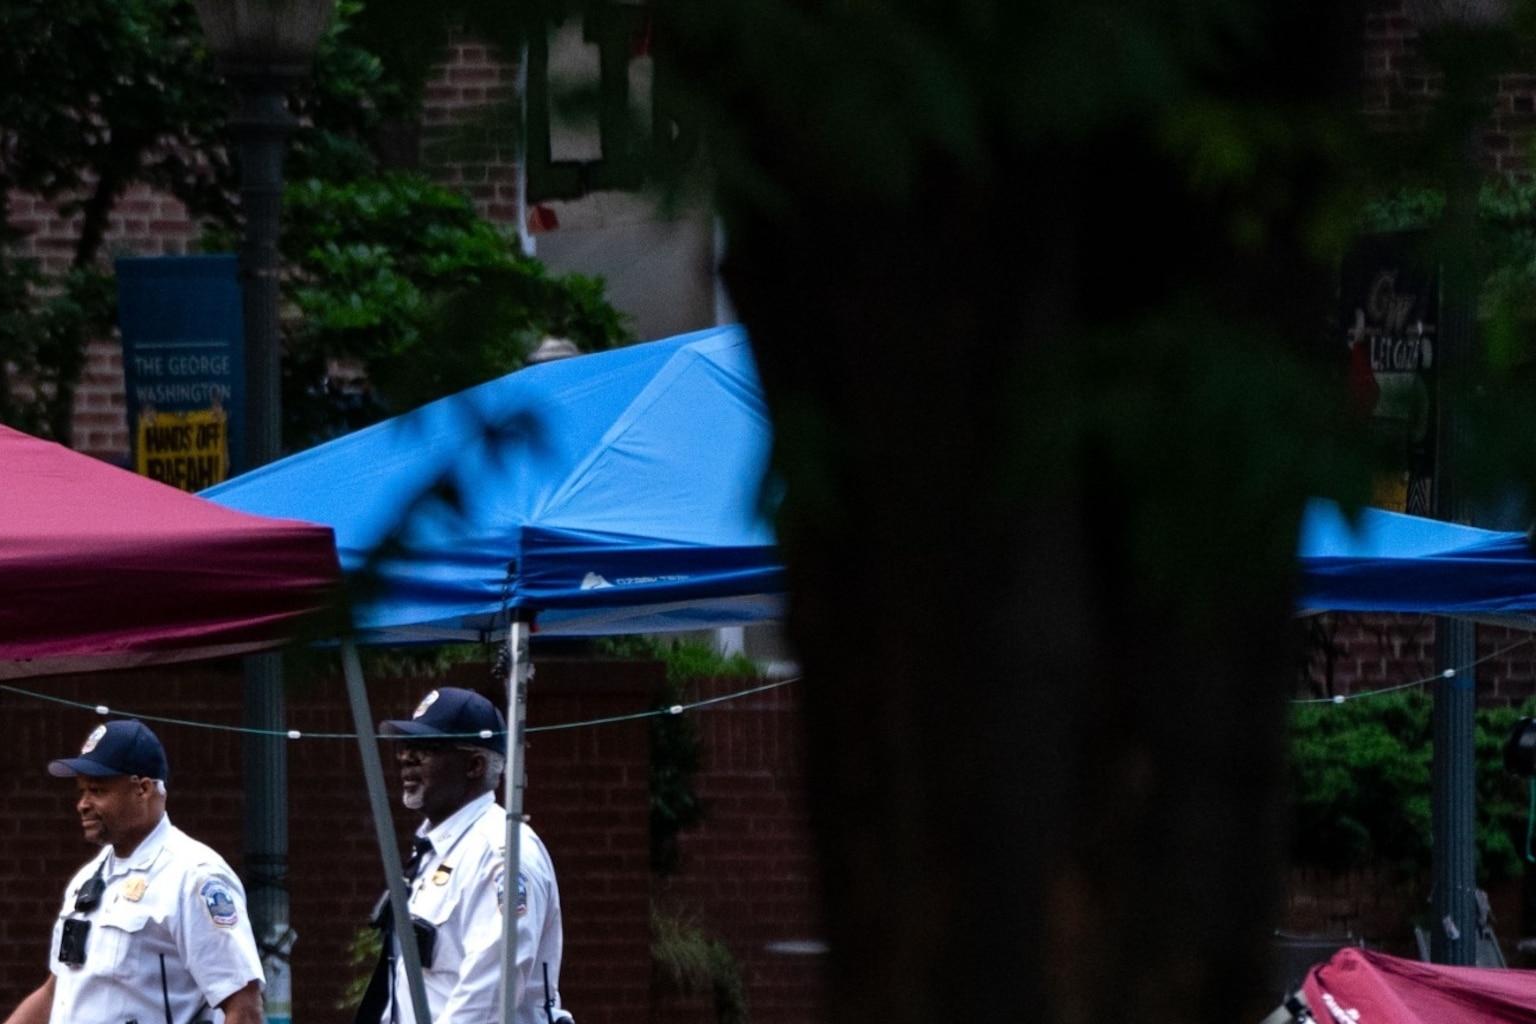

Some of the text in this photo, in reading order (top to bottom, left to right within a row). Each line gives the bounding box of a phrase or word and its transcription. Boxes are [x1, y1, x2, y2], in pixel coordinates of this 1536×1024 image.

[134, 355, 230, 376] THE GEORGE
[1370, 336, 1392, 371] LET
[135, 384, 231, 403] WASHINGTON
[146, 422, 220, 453] HANDS OFF
